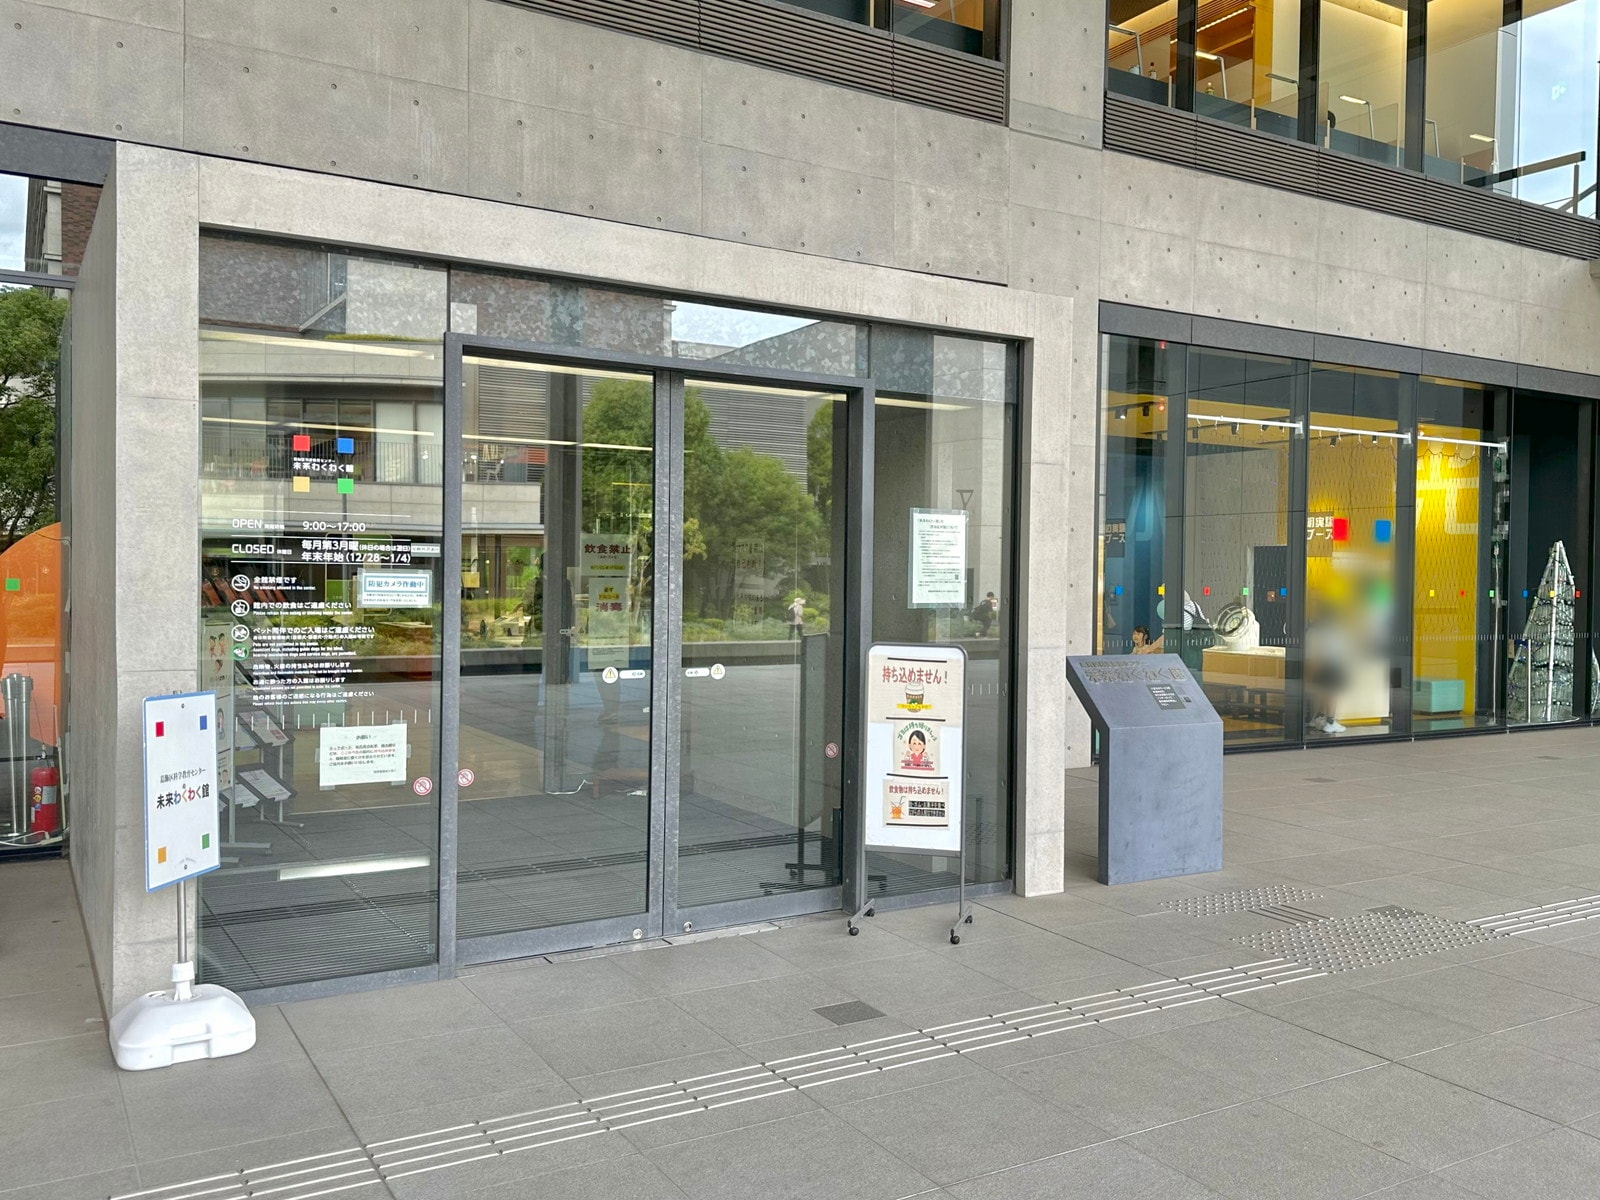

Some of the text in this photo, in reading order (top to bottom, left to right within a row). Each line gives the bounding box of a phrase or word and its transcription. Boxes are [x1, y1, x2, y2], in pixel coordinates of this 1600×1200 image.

[232, 518, 262, 529] OPEN
[231, 543, 275, 554] CLOSED
[584, 544, 631, 554] 飲食禁止
[368, 580, 424, 588] 防犯カメラ作動中
[596, 602, 622, 612] 消毒
[156, 783, 210, 809] 未来わくわく館
